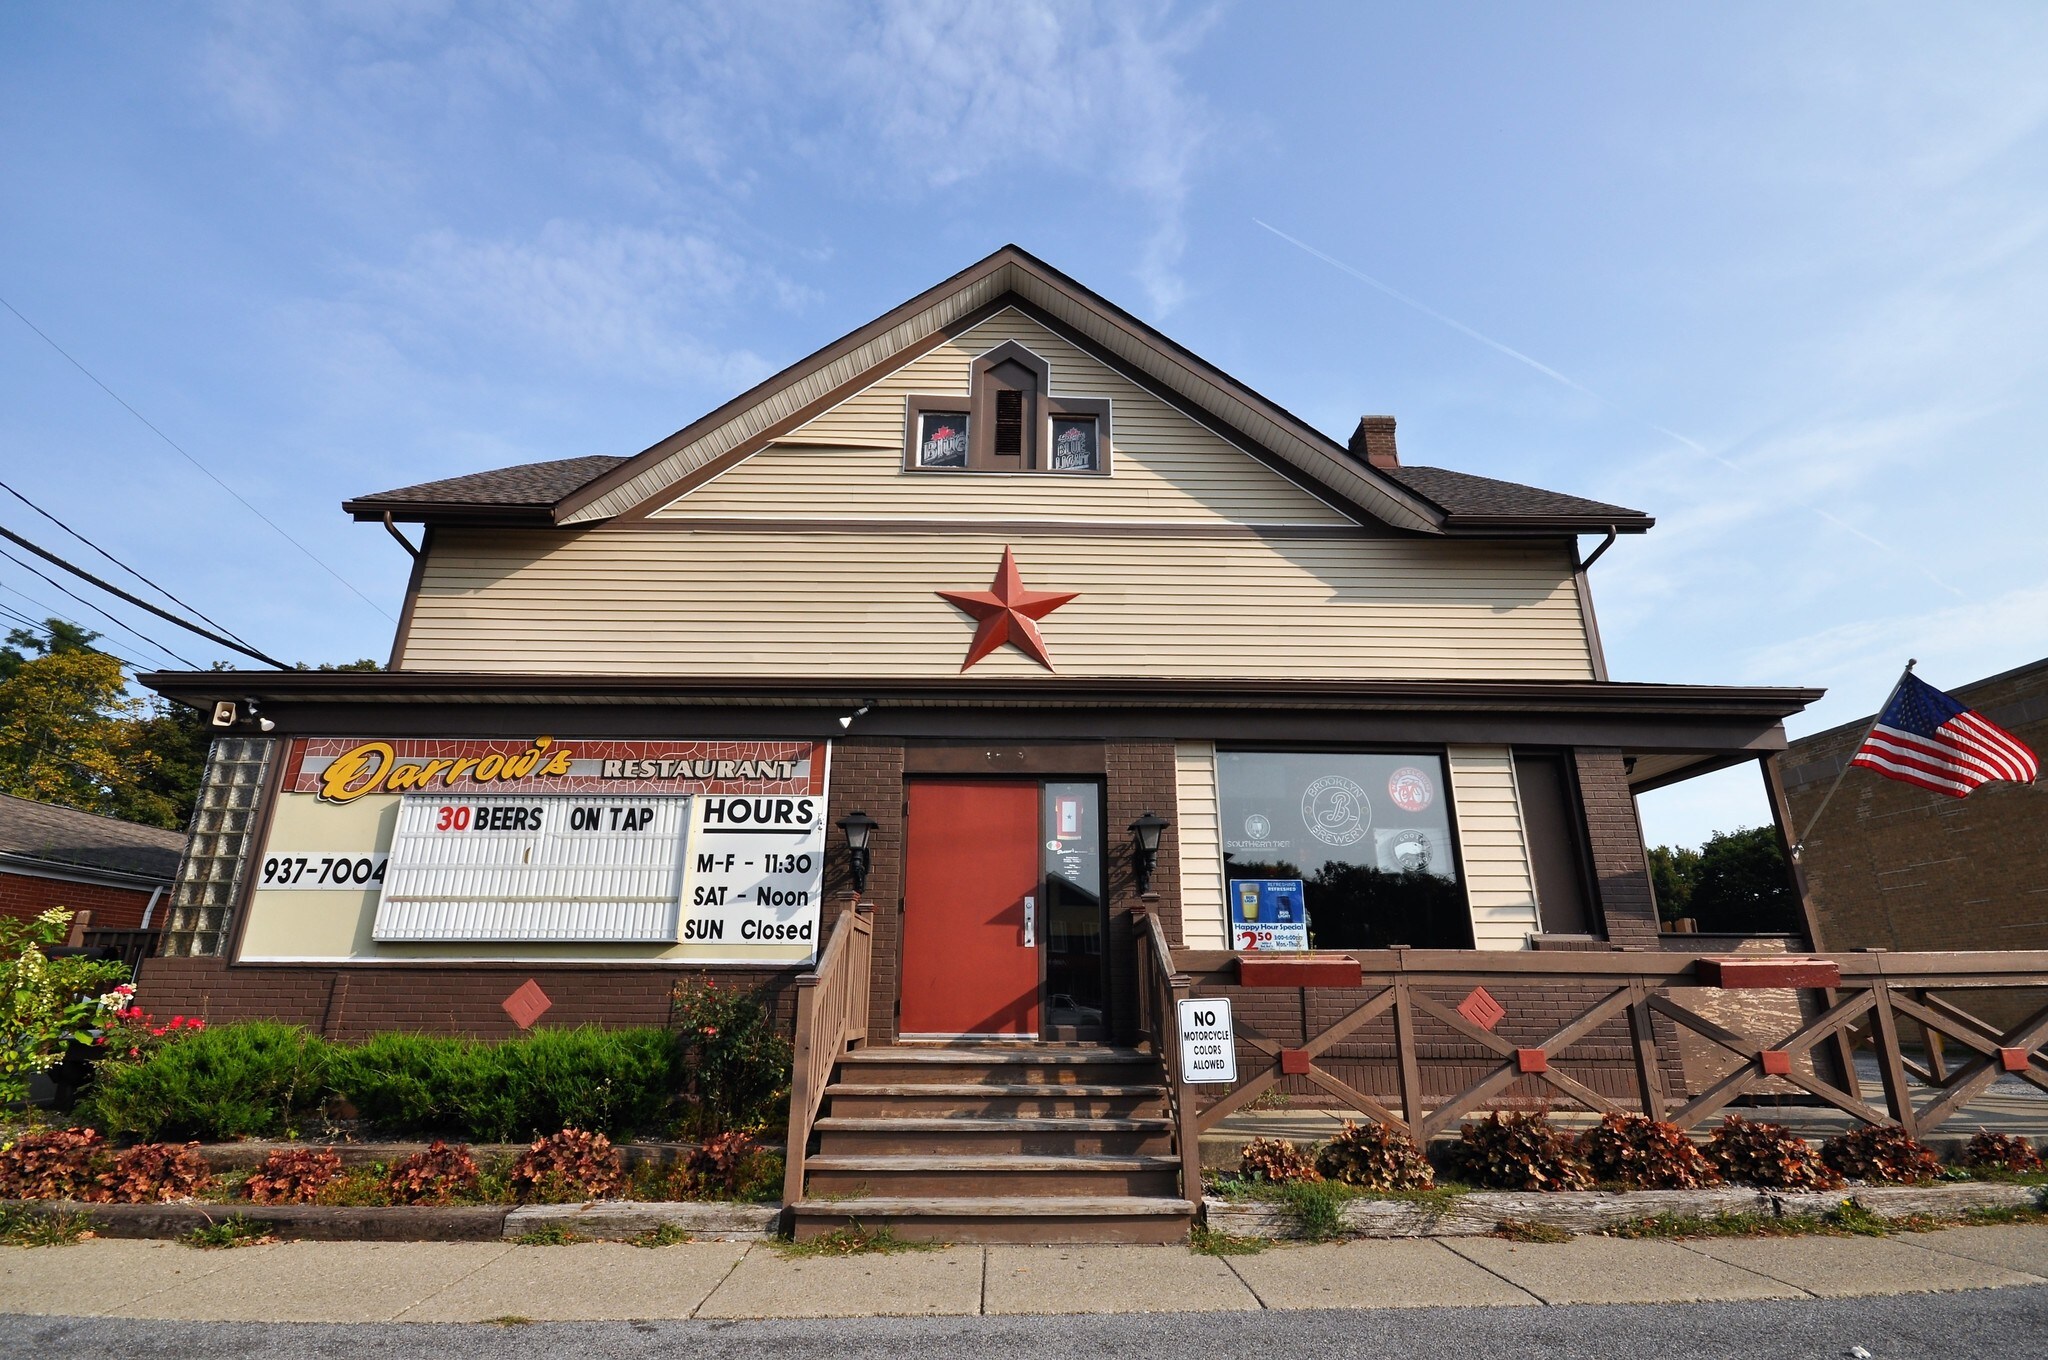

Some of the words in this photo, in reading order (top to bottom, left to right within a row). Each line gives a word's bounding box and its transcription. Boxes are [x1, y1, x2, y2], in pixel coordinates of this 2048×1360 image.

[319, 735, 572, 802] Darrow's
[602, 759, 797, 780] RESTAURANT
[1308, 777, 1363, 798] BROOKLYN
[436, 806, 470, 830] 30
[474, 807, 543, 831] BEERS
[570, 807, 601, 831] ON
[609, 807, 654, 831] TAP
[703, 799, 813, 824] HOURS
[1227, 840, 1272, 848] SOUTHERN
[1311, 824, 1364, 844] BREWERY
[263, 857, 386, 884] 937-7004
[696, 854, 735, 873] M-F
[764, 854, 812, 873] 11:30
[693, 886, 728, 906] SAT
[757, 886, 808, 906] Noon
[684, 919, 724, 939] SUN
[740, 919, 812, 940] Closed
[1194, 1010, 1216, 1027] NO
[1183, 1030, 1229, 1042] MOTORCYCLE
[1193, 1045, 1222, 1056] COLORS
[1193, 1059, 1225, 1070] ALLOWED
